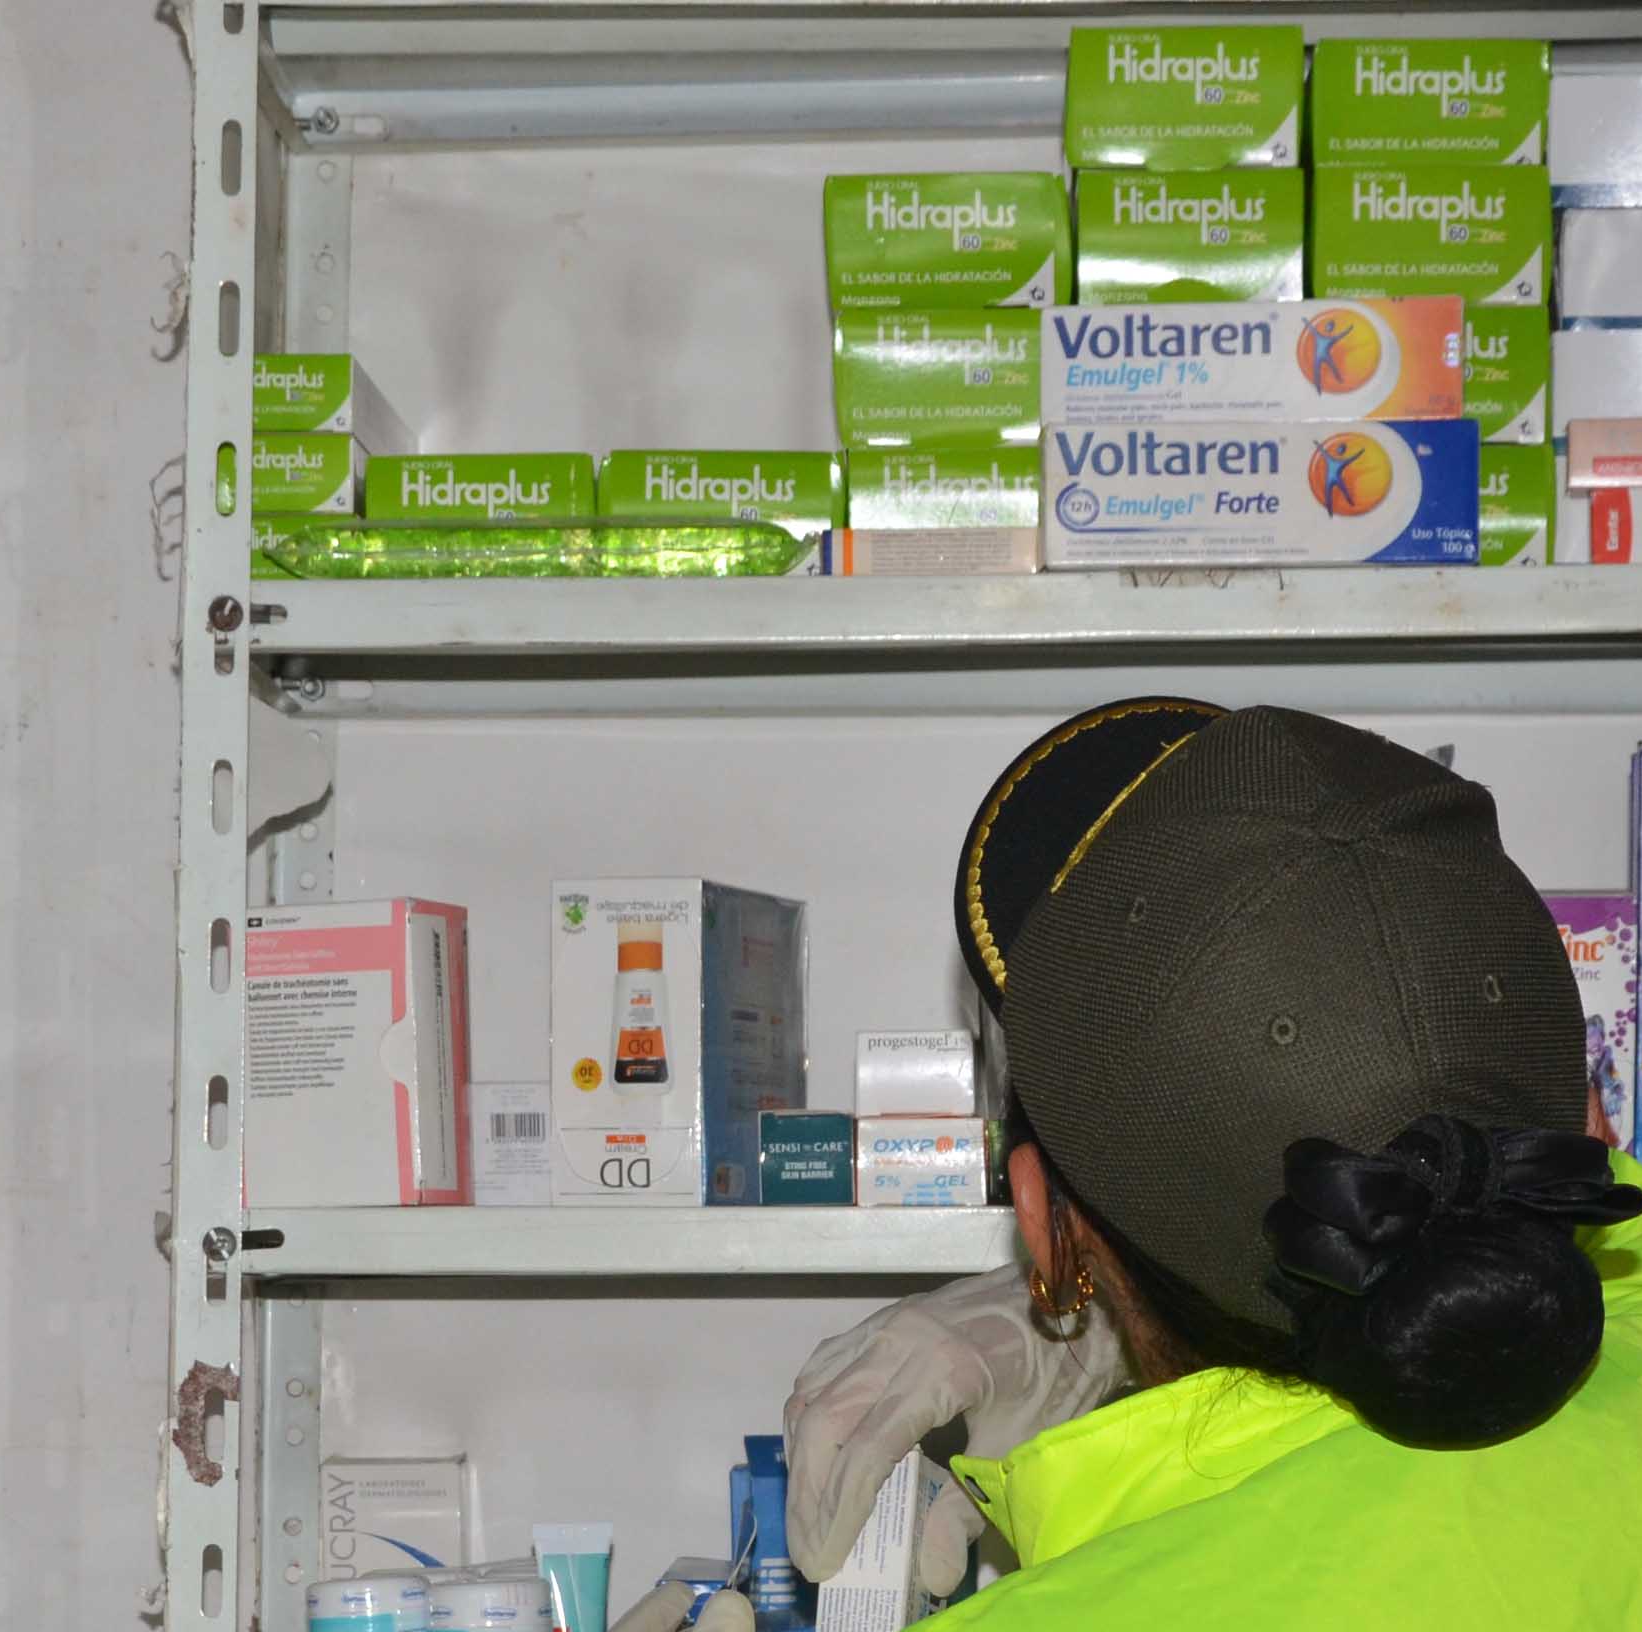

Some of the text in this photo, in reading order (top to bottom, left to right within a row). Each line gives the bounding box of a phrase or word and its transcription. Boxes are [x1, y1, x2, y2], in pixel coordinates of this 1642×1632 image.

[1108, 42, 1259, 103] Hidraplus
[1355, 55, 1506, 117] Hidraplus
[1204, 88, 1222, 103] 60
[1450, 101, 1469, 115] 60
[1100, 126, 1138, 137] SABOR
[1344, 138, 1382, 150] SABOR
[866, 190, 1017, 250] Hidraplus
[1113, 185, 1265, 245] Hidraplus
[1353, 181, 1506, 242] Hidraplus
[1449, 227, 1469, 241] 60
[876, 324, 1027, 385] Hidraplus
[1054, 315, 1272, 358] Voltaren
[1065, 362, 1209, 390] Emulgel 1%
[1055, 431, 1280, 476] Voltaren
[402, 469, 551, 520] Hidraplus
[645, 464, 796, 520] Hidraplus
[1105, 490, 1280, 519] Emulgel Forte
[868, 1034, 949, 1050] progestogel
[600, 1158, 650, 1188] DD
[874, 1175, 969, 1187] 5% GEL
